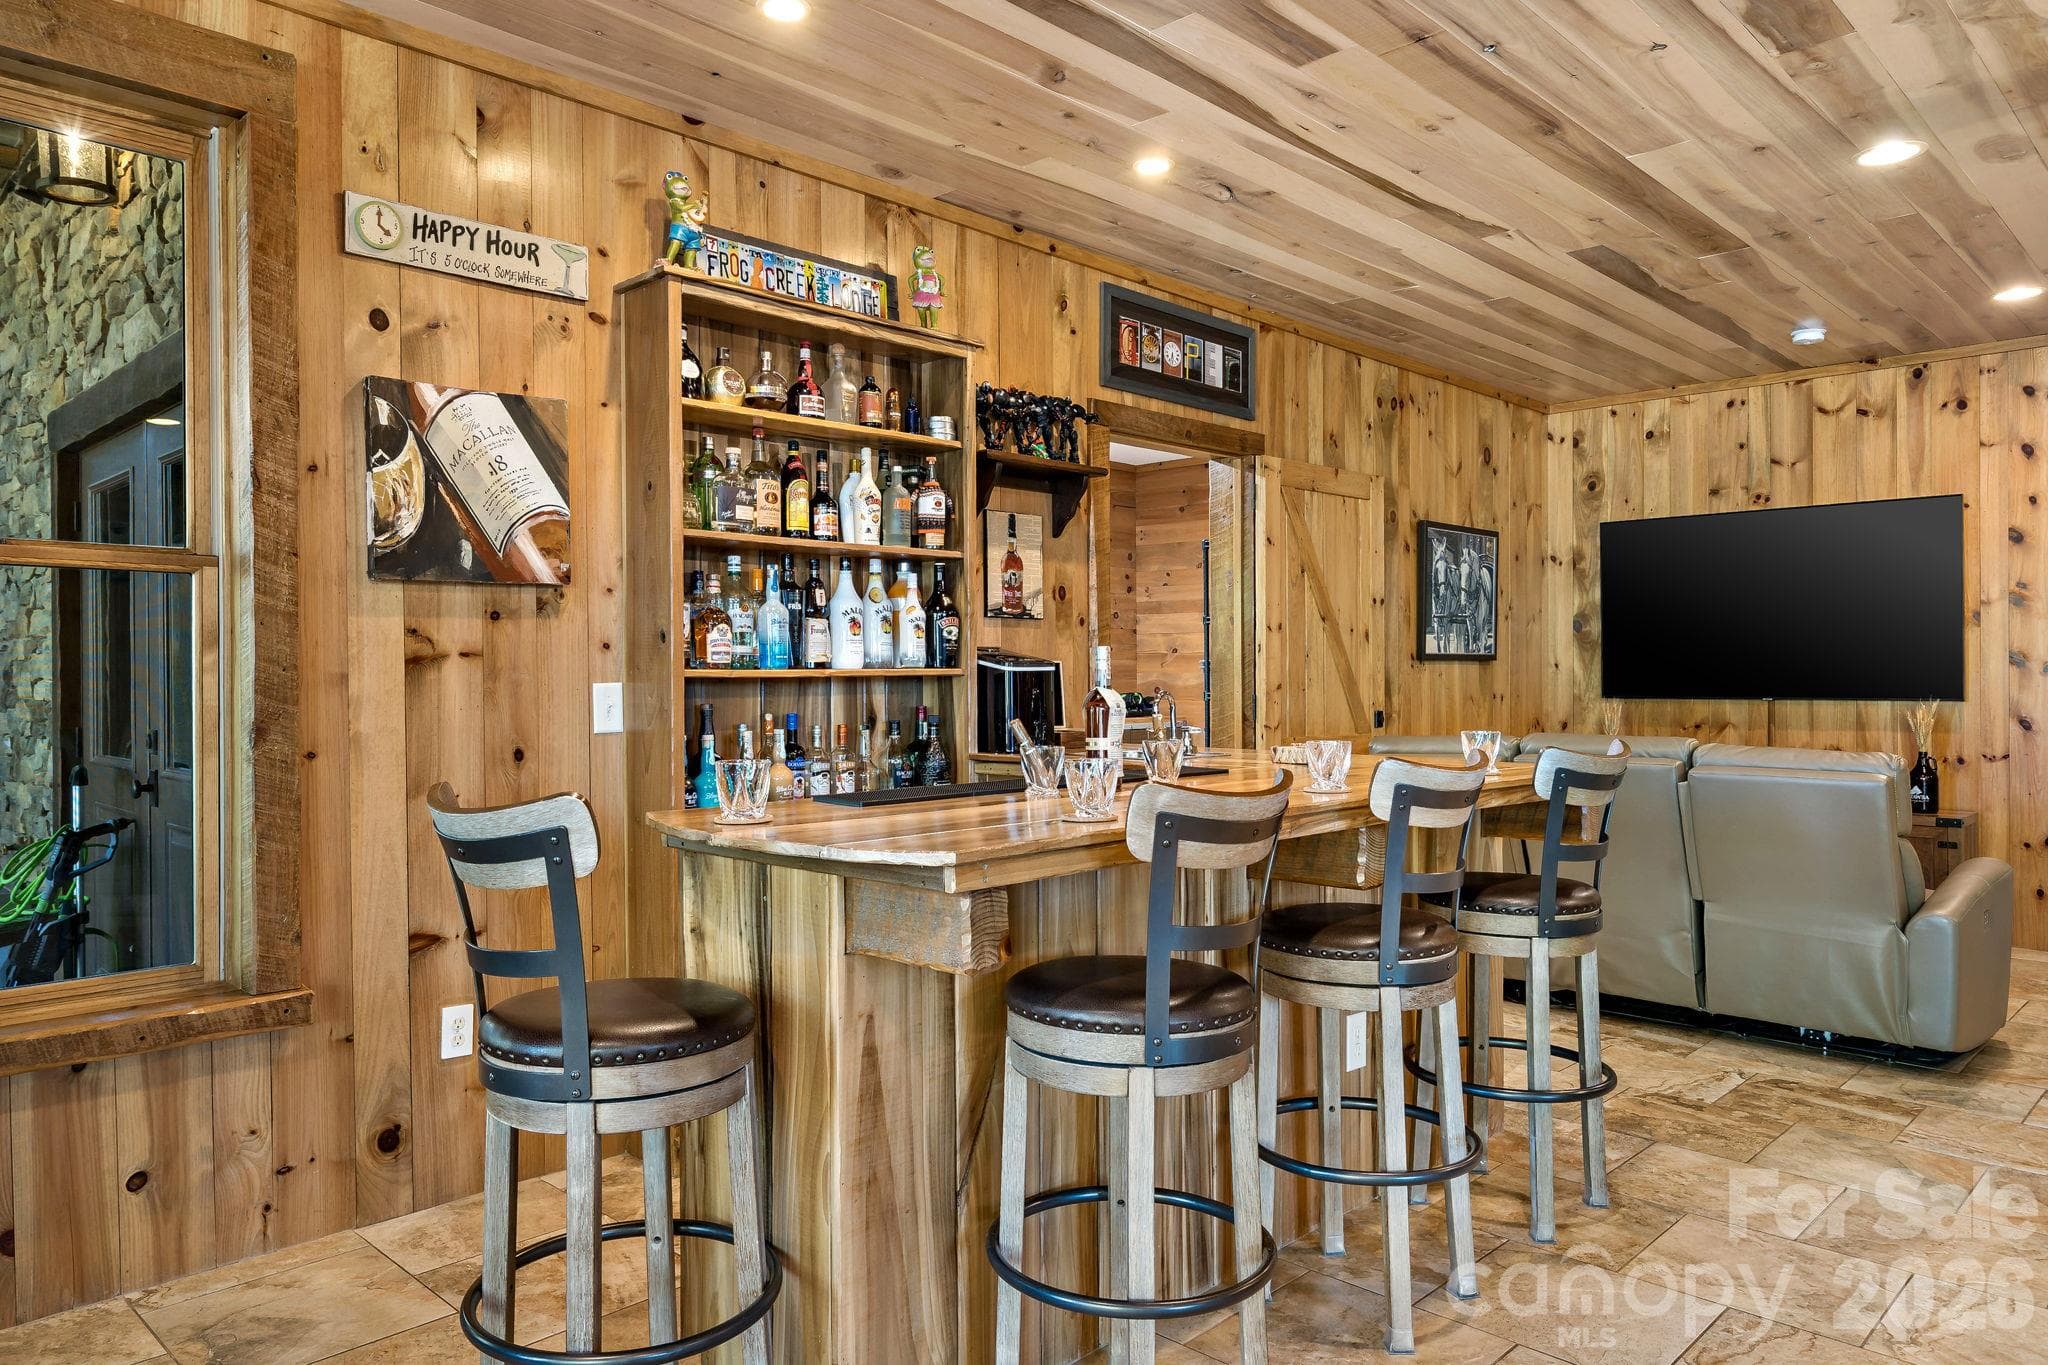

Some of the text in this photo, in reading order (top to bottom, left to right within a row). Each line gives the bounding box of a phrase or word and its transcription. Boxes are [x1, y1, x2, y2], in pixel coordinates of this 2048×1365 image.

[412, 212, 540, 267] HAPPY HOUR
[409, 245, 437, 266] IT'S
[444, 253, 451, 267] 5
[494, 265, 548, 288] SOMEWHERE
[707, 251, 880, 317] FROG CREEK LODGE
[448, 425, 518, 473] MACALLAN
[487, 454, 508, 477] 18
